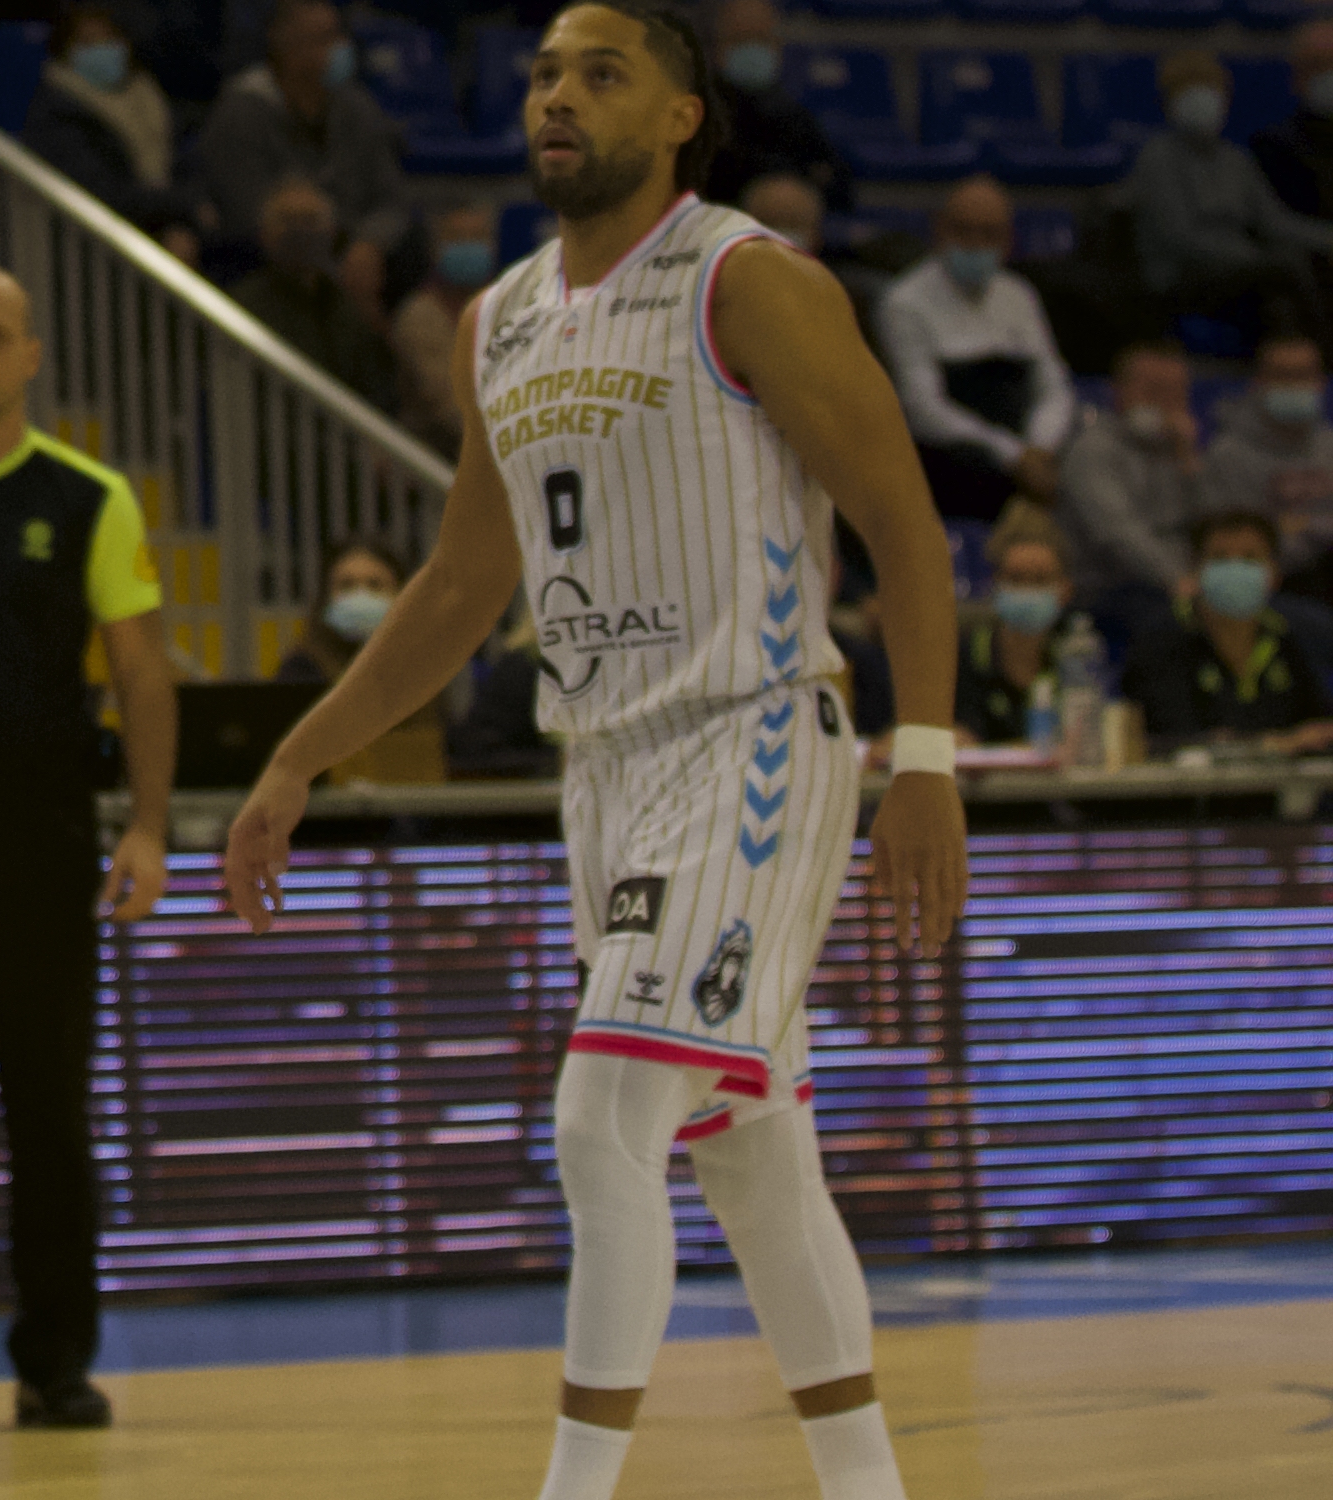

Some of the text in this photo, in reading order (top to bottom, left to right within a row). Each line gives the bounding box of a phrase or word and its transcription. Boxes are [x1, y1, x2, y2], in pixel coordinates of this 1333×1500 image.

[487, 367, 673, 423] HAMPAGNE
[496, 402, 623, 461] BASKET
[544, 467, 583, 550] 0
